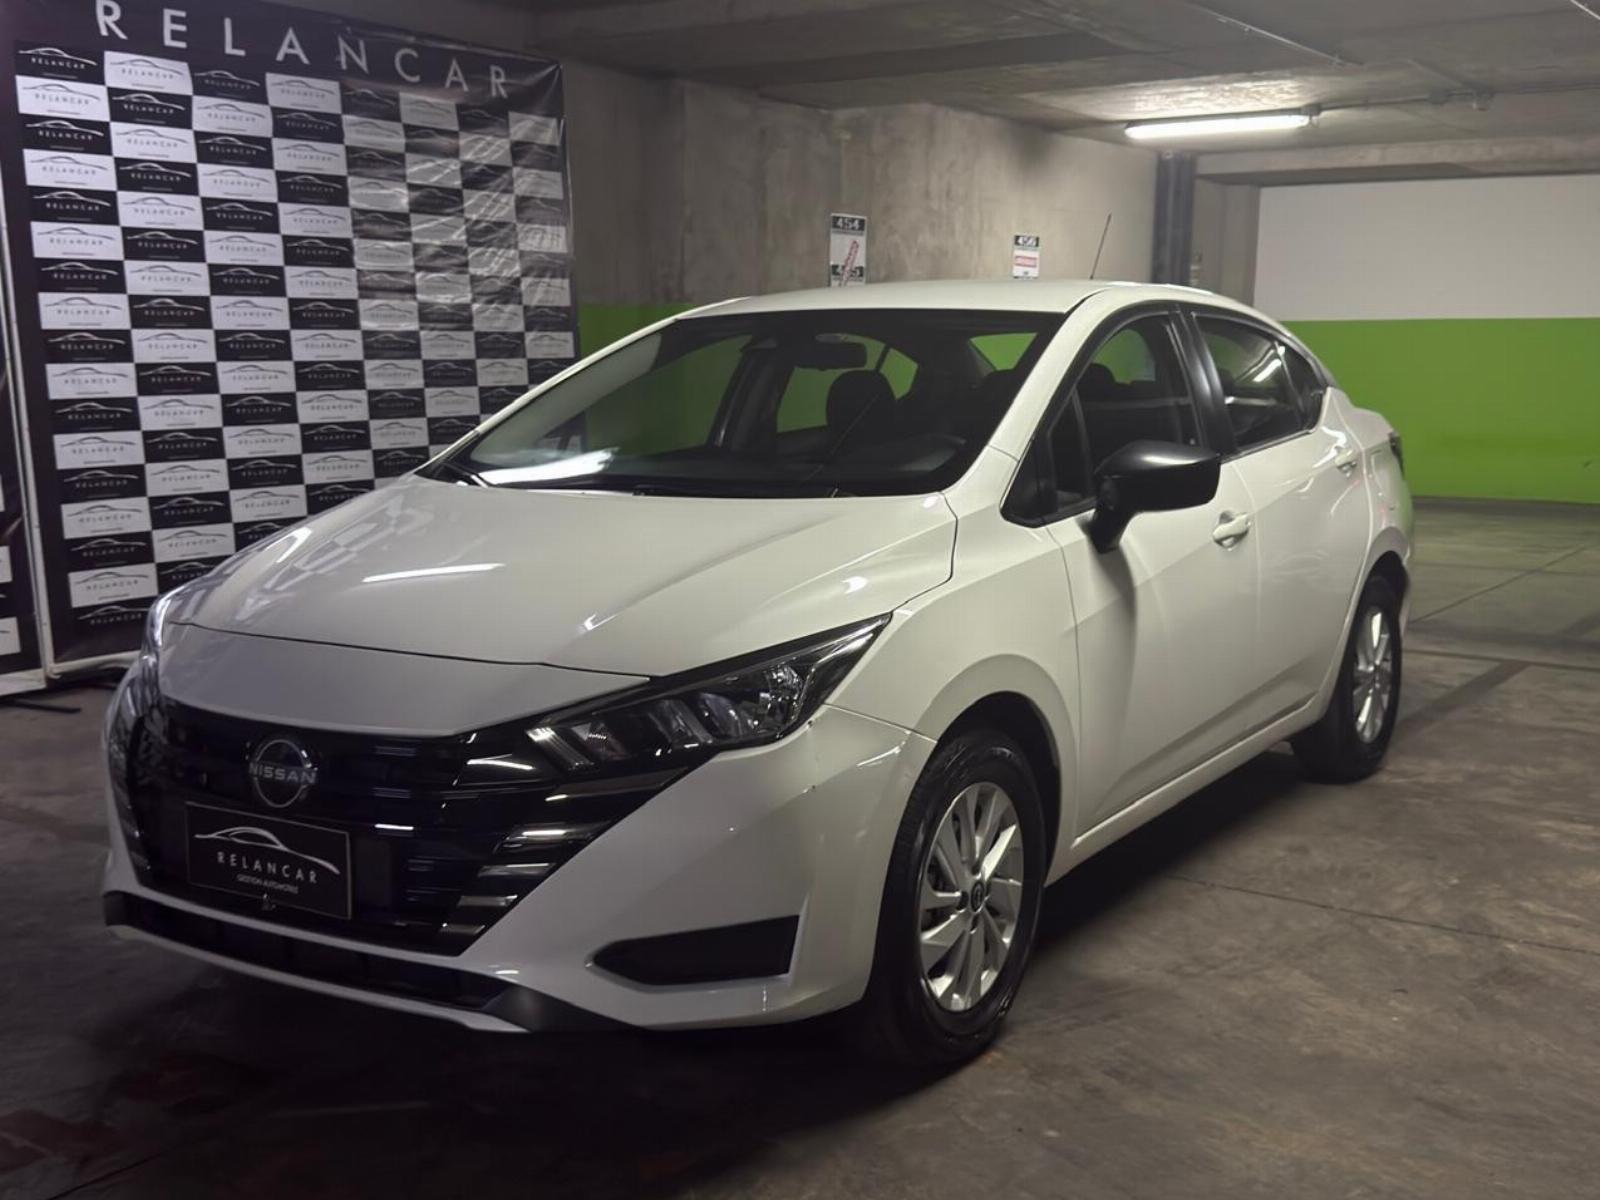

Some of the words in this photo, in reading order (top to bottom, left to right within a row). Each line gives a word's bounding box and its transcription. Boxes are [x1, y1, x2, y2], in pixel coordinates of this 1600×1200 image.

[95, 0, 509, 98] RELANCAR
[249, 762, 316, 784] NISSAN
[217, 851, 317, 884] RELANCAR
